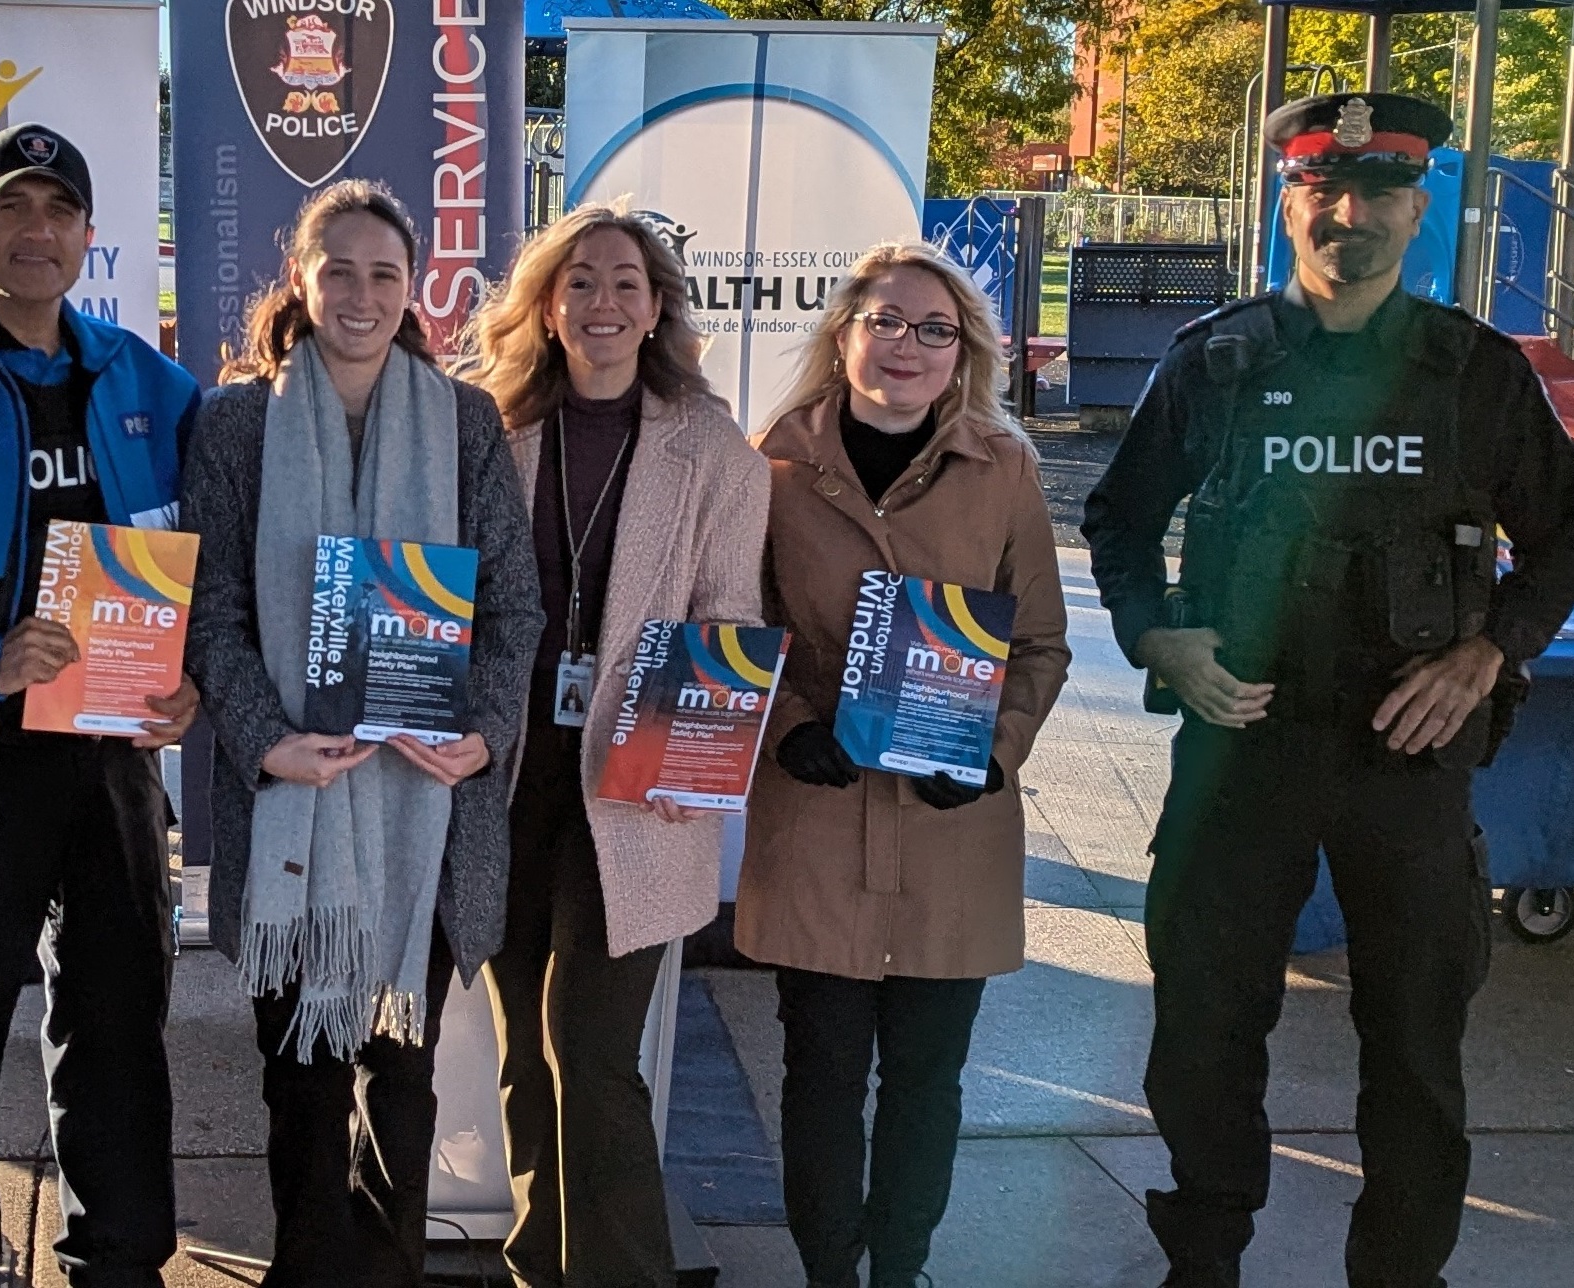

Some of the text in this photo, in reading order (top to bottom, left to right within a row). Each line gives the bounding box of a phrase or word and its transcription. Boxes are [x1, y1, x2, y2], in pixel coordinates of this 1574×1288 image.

[265, 112, 359, 137] POLICE
[423, 0, 487, 317] SERVICE
[210, 144, 241, 334] ssionalism
[692, 251, 817, 267] WINDSOR-ESSEX
[686, 276, 781, 310] ALTH
[723, 317, 739, 332] de
[743, 317, 817, 333] Windsor-co
[1263, 391, 1293, 405] 390
[28, 445, 97, 490] OLI
[1264, 435, 1424, 474] POLICE
[58, 523, 88, 628] South Cen
[92, 599, 178, 628] more
[305, 534, 336, 689] East Windsor
[325, 536, 355, 686] Walkerville &
[870, 572, 904, 675] Downtown
[370, 613, 462, 642] more
[840, 570, 887, 700] Windsor
[88, 637, 155, 651] Neighbourhood
[115, 648, 135, 658] Plan
[368, 649, 439, 665] Neighbourhood
[652, 619, 678, 669] South
[368, 658, 418, 671] Safety Plan
[905, 646, 995, 681] more
[612, 619, 662, 746] Walkerville
[902, 681, 970, 700] Neighbourhood
[677, 687, 759, 711] more
[900, 690, 948, 706] Safety Plan
[670, 728, 715, 739] Safety Plan
[672, 719, 735, 732] Neighbourhood
